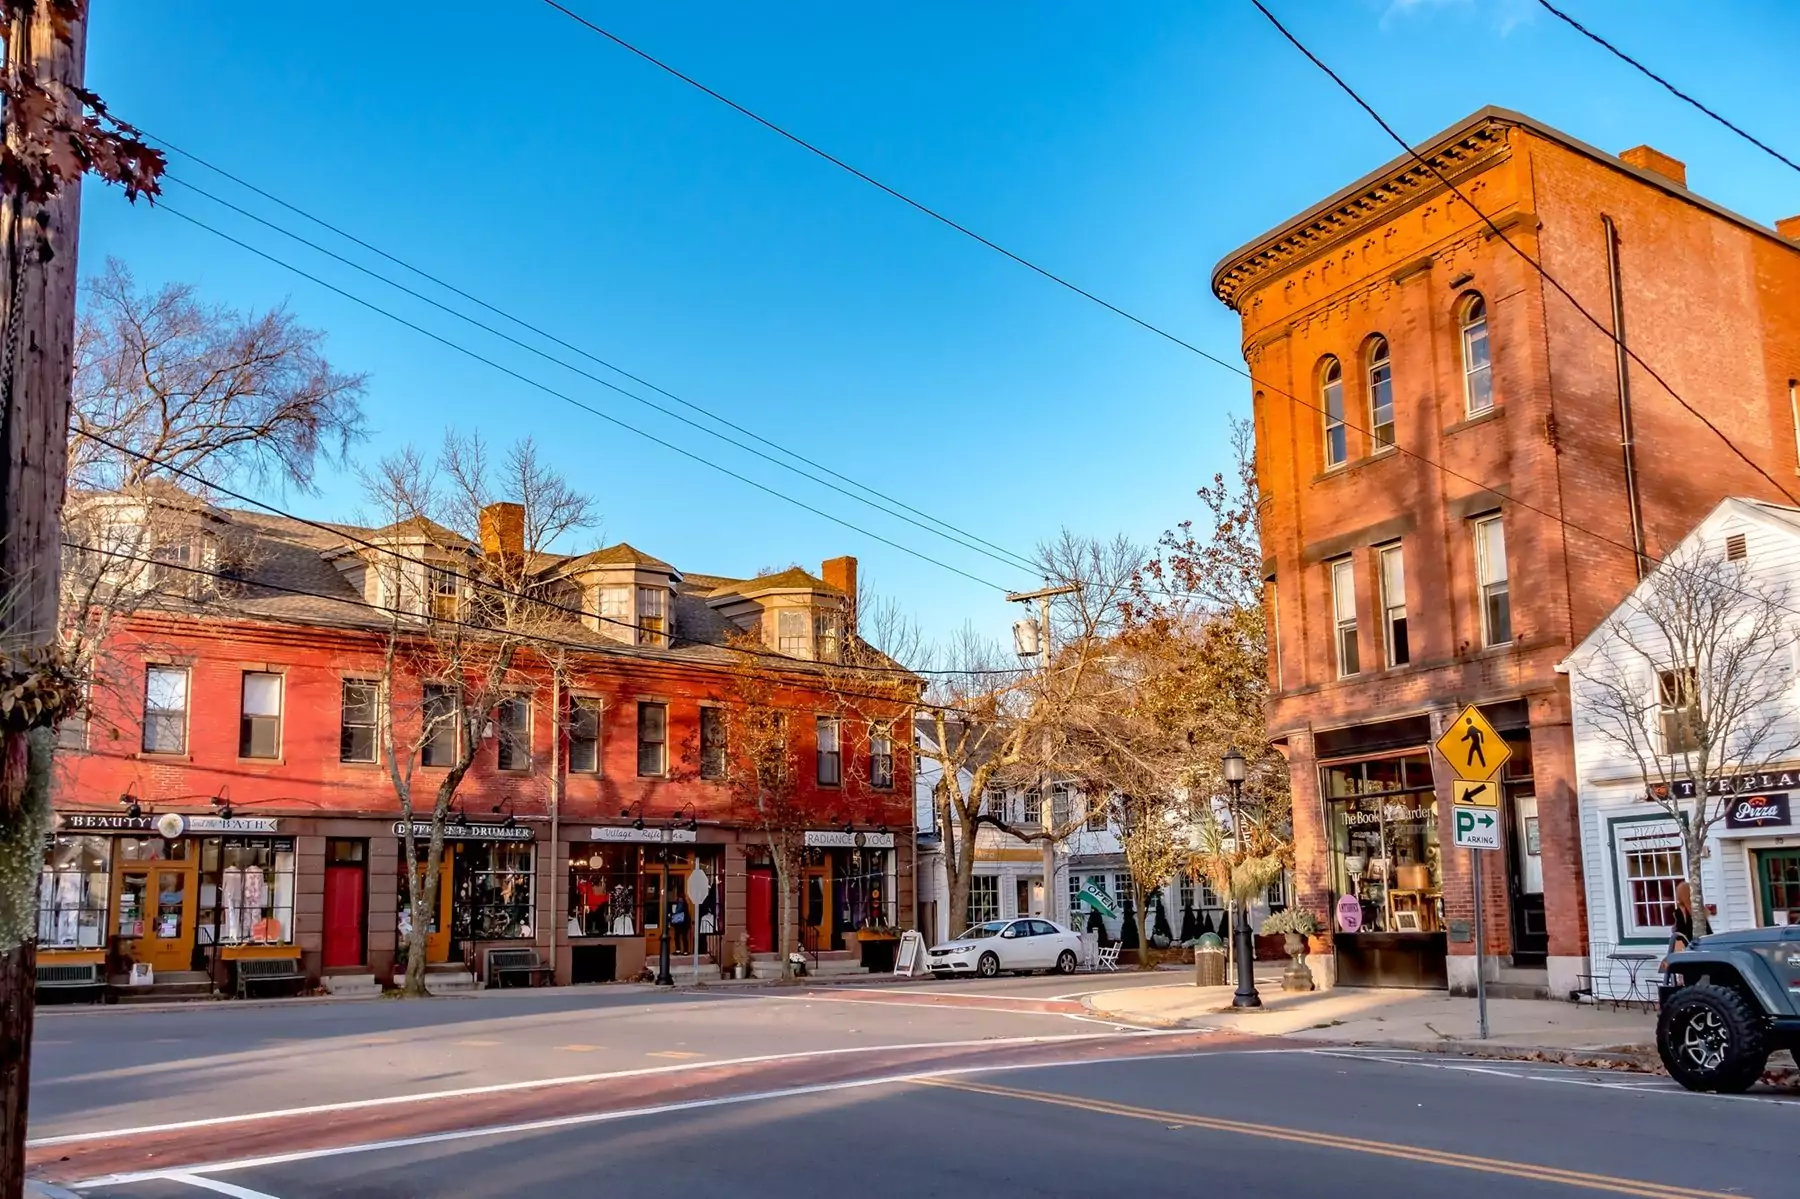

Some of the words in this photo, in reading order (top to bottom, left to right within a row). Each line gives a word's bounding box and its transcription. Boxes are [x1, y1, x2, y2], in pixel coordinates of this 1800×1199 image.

[1743, 773, 1800, 789] PLA
[1341, 811, 1356, 825] The
[1357, 808, 1380, 824] Book
[1394, 804, 1434, 821] arden
[1736, 802, 1778, 819] Pizza
[70, 816, 151, 827] BEAUTY
[220, 819, 267, 829] BATH
[397, 824, 466, 836] DFFEENT
[471, 826, 530, 837] DRUMMER
[605, 828, 632, 840] Village
[1634, 825, 1664, 837] PIZZA
[808, 833, 852, 845] RADIANCE
[866, 835, 892, 845] YOGA
[1632, 838, 1672, 850] SALADS
[1088, 885, 1117, 911] OPEN
